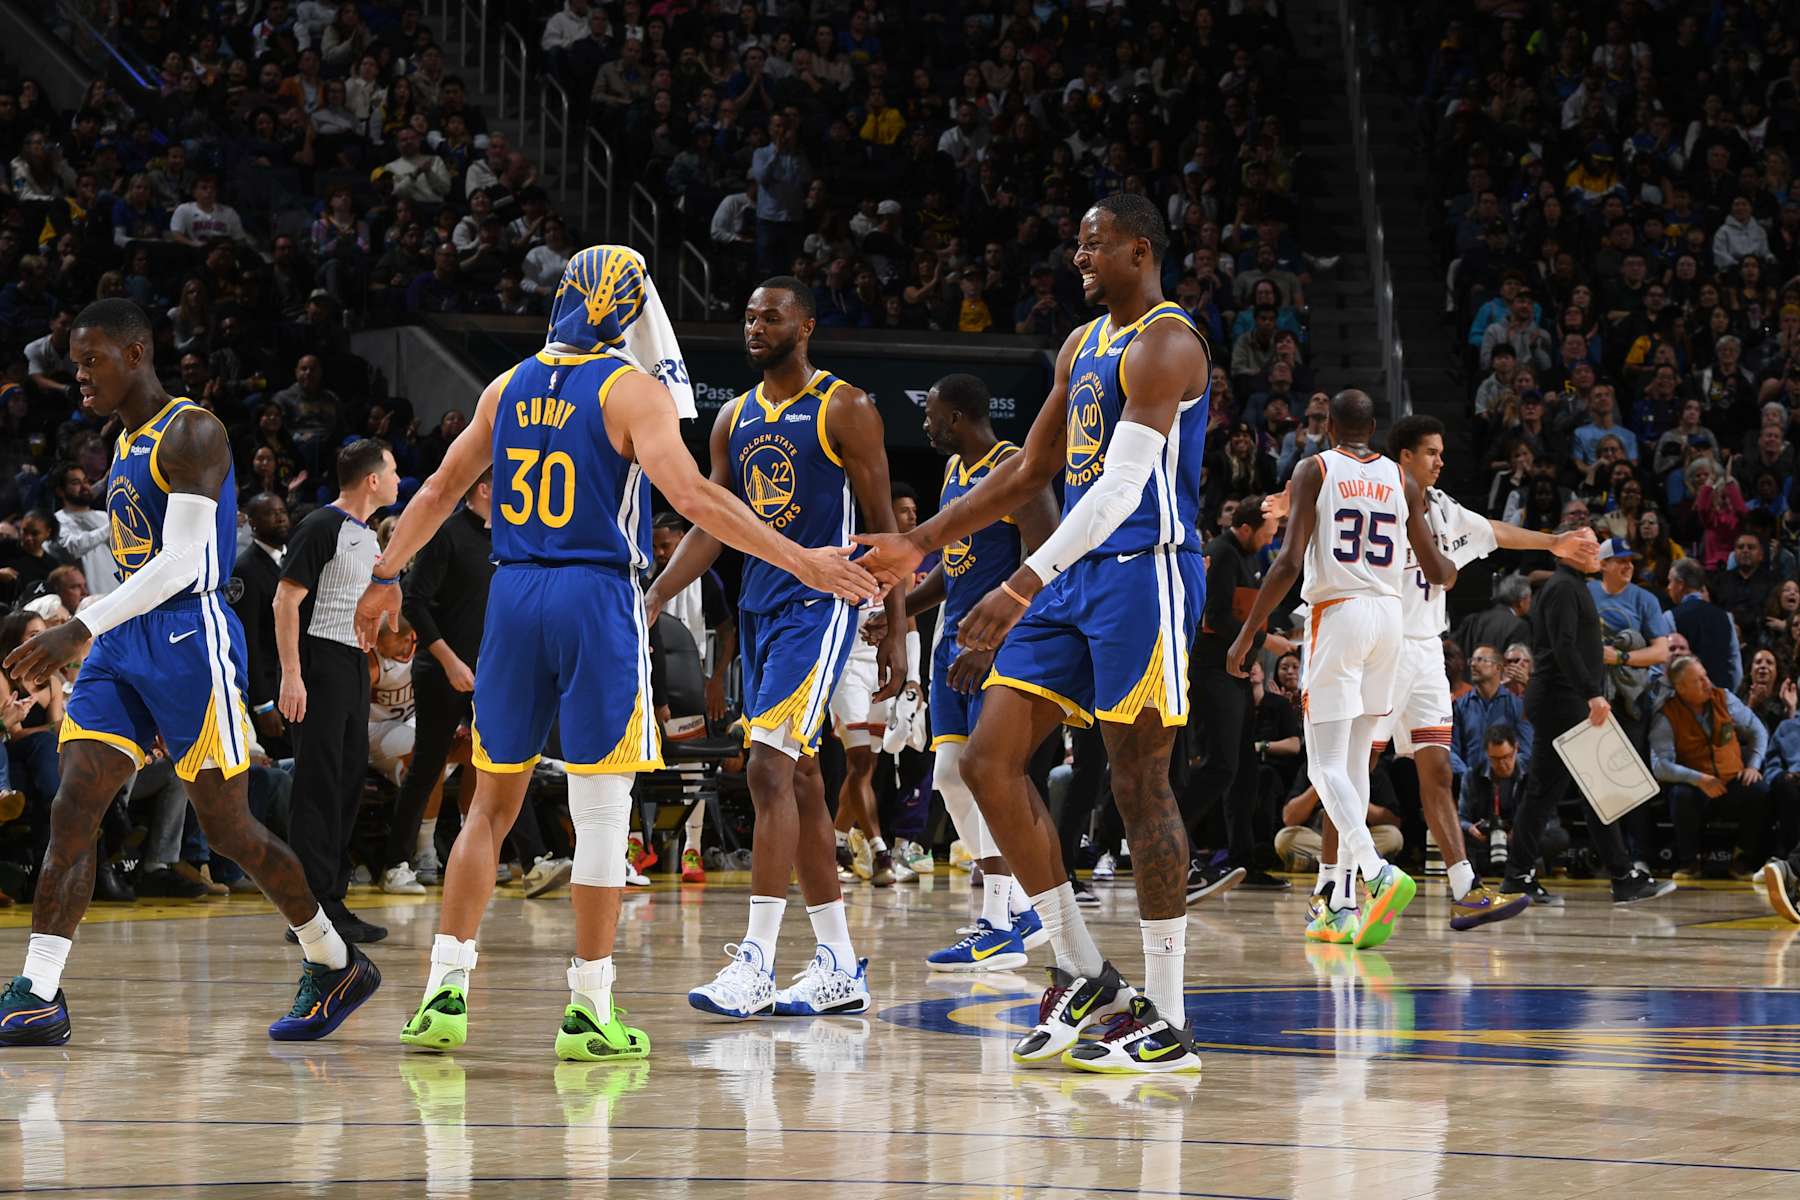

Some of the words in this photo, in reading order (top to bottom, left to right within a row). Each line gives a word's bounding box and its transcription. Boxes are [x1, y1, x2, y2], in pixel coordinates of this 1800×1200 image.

[695, 383, 735, 400] Pass
[989, 397, 1016, 410] ass
[515, 397, 576, 430] CURRY
[1082, 403, 1098, 428] 00
[739, 433, 772, 462] GOLDEN
[774, 434, 798, 457] STATE
[771, 461, 790, 483] 22
[500, 447, 576, 529] 30
[1338, 479, 1394, 503] DURANT
[1333, 508, 1396, 567] 35
[1452, 535, 1468, 552] DE
[1416, 570, 1430, 601] 4
